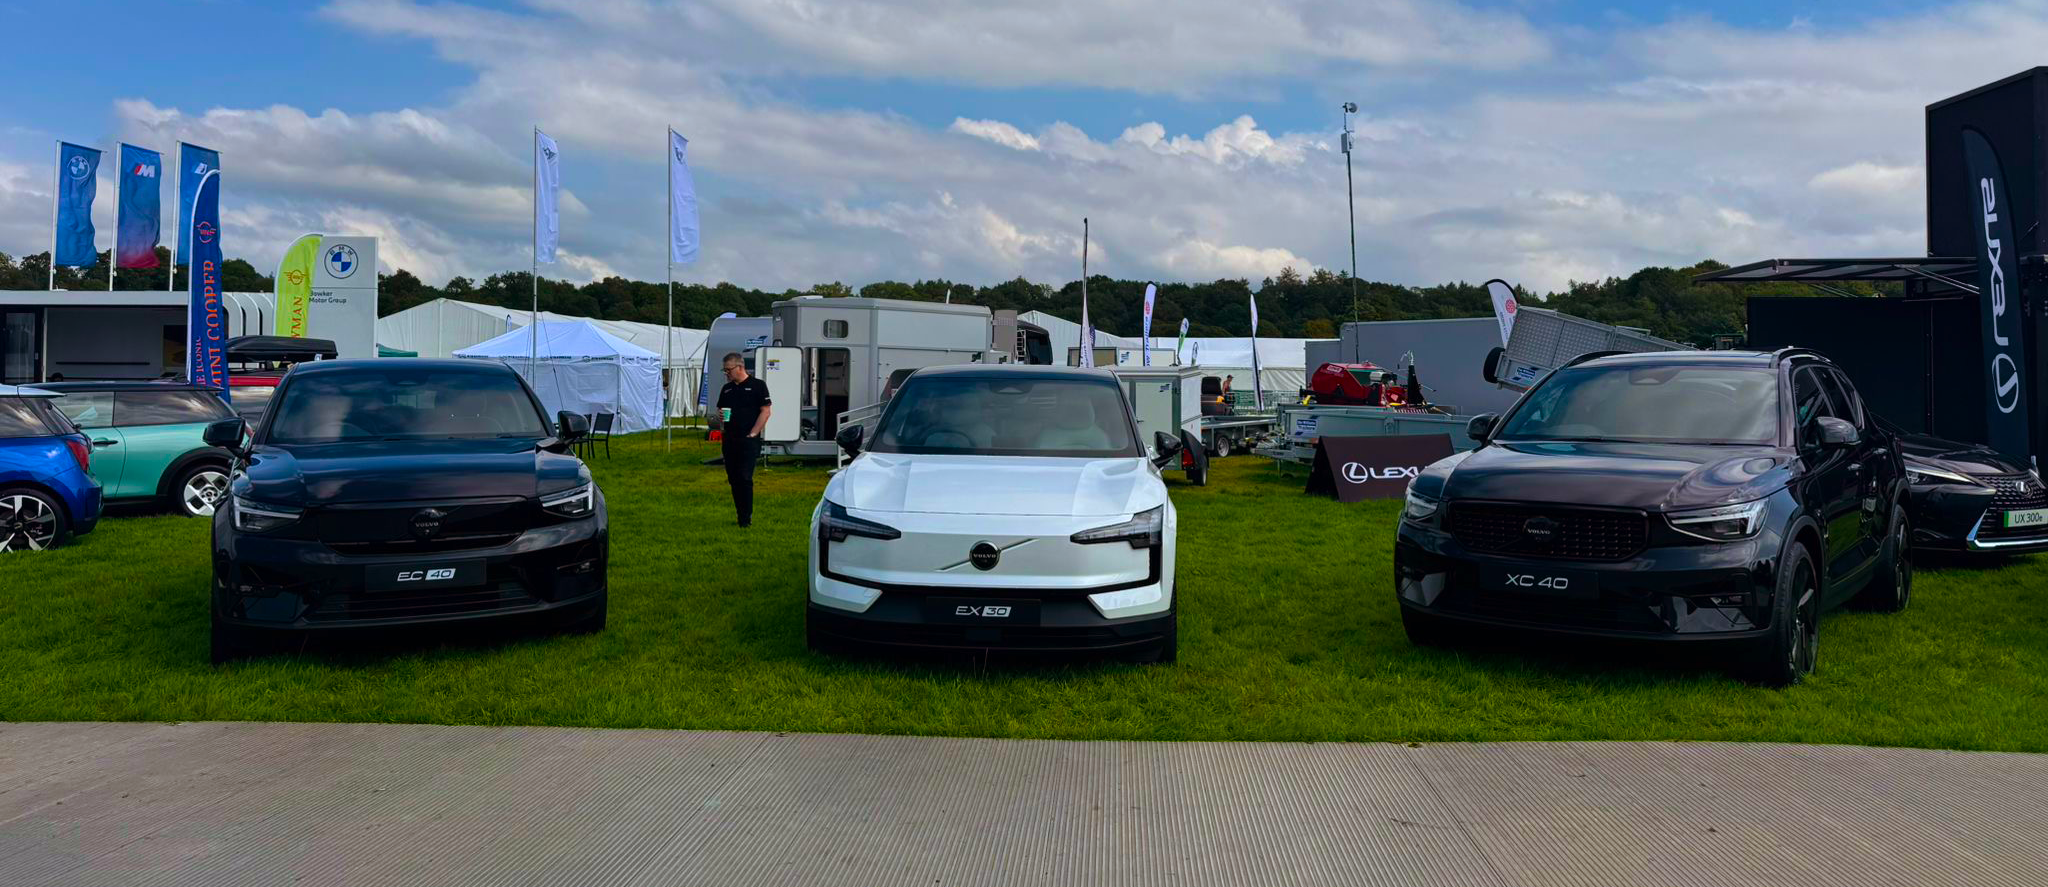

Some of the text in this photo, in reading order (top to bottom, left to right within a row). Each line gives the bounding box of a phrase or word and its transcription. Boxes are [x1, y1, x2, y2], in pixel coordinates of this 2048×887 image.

[1369, 466, 1420, 479] LEX
[2014, 512, 2043, 524] UX 300e
[397, 569, 454, 581] EC 40
[1505, 573, 1569, 589] XC 40
[955, 606, 1009, 616] EX 30
